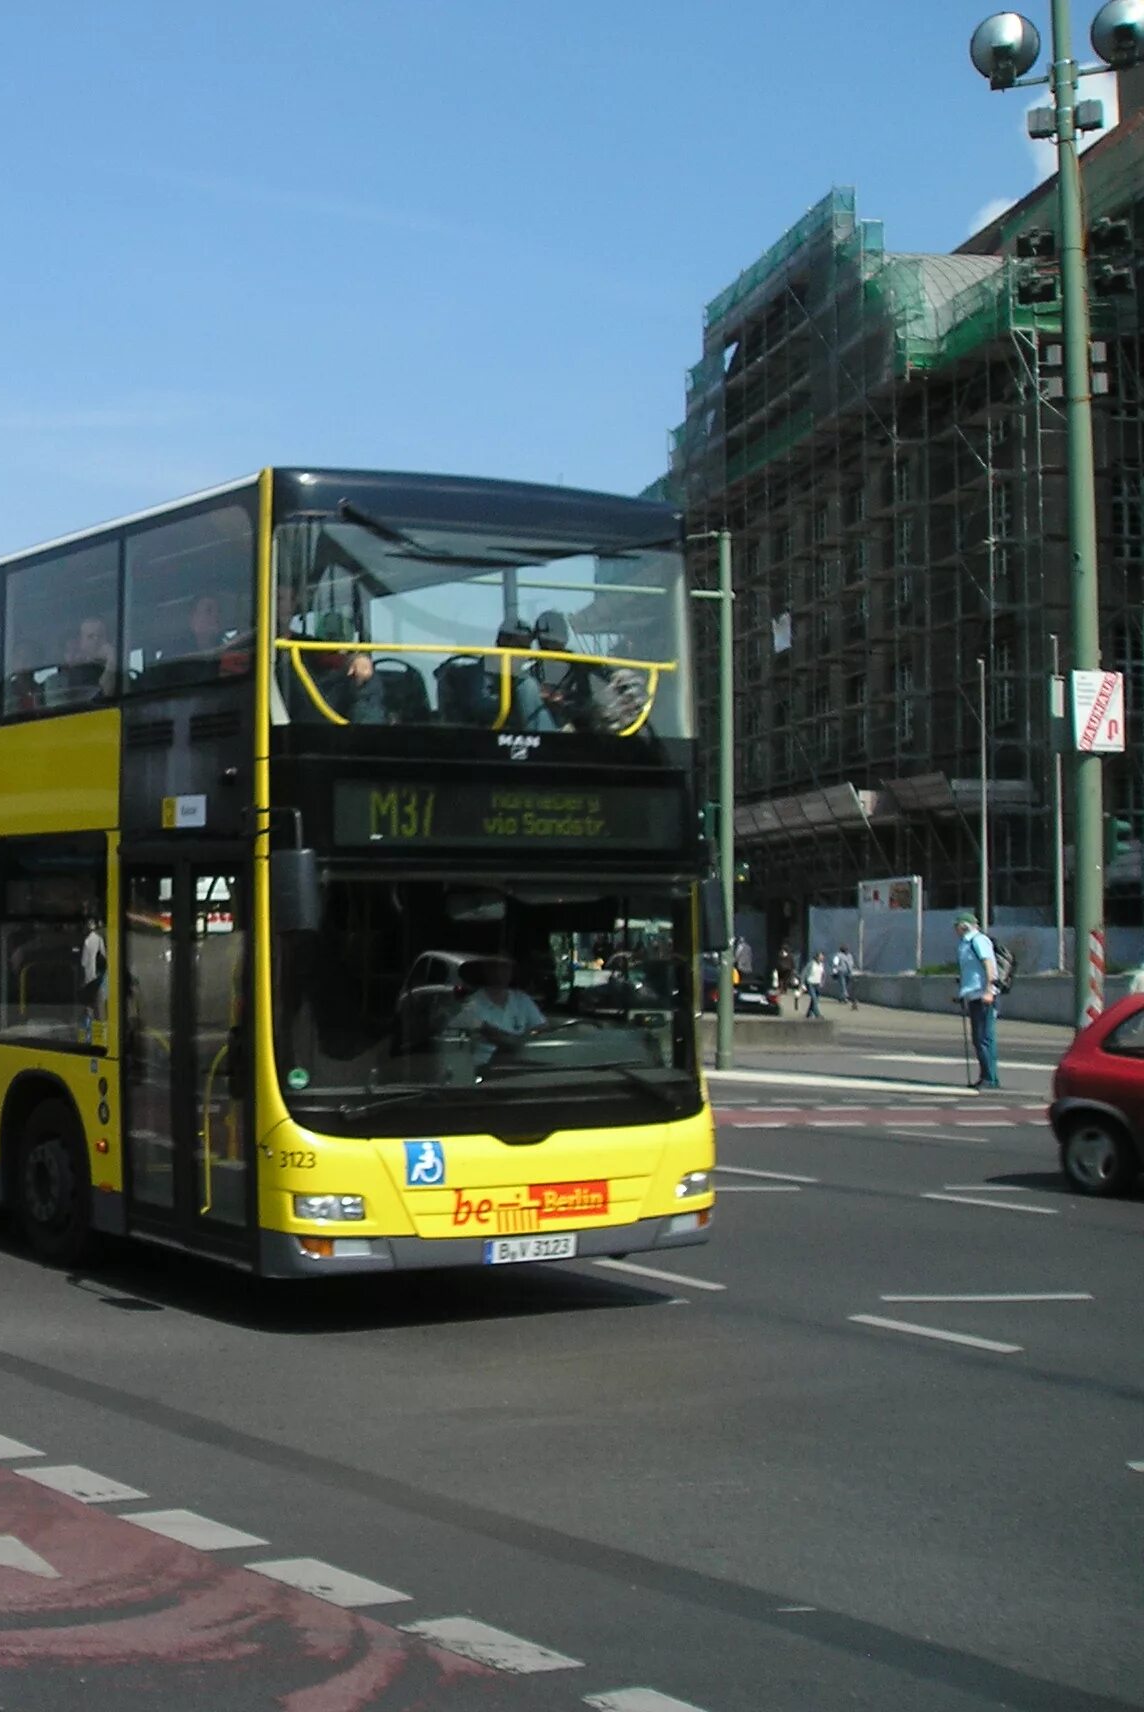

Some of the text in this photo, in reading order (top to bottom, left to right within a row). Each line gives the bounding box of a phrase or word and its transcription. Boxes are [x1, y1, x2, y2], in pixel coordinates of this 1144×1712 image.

[498, 734, 541, 748] MAN
[279, 1150, 317, 1169] 3123
[452, 1187, 604, 1226] be Berlin
[533, 1237, 571, 1257] 3123
